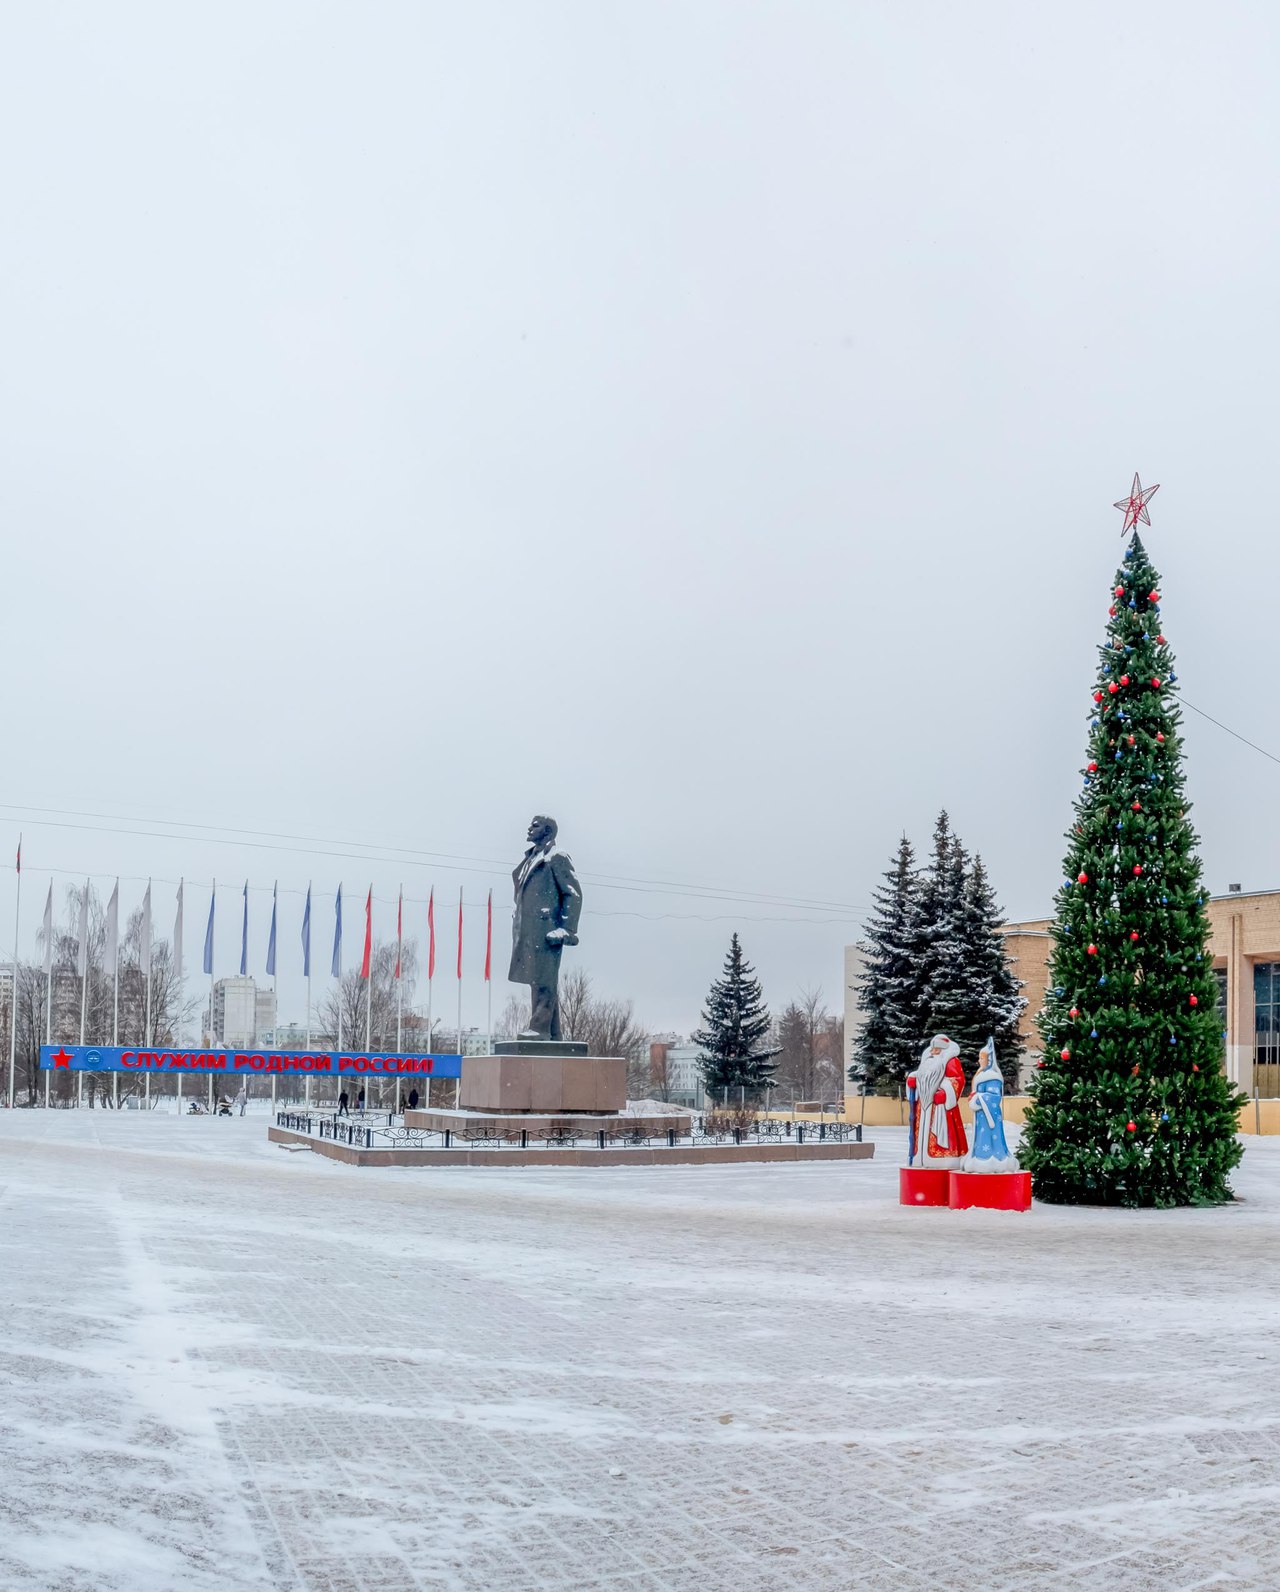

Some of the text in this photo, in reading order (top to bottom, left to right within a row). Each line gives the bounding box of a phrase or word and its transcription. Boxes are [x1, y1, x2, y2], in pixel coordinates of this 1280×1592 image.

[121, 1051, 433, 1074] СЛУЖИМ РОДНОЙ РОССИИ!
